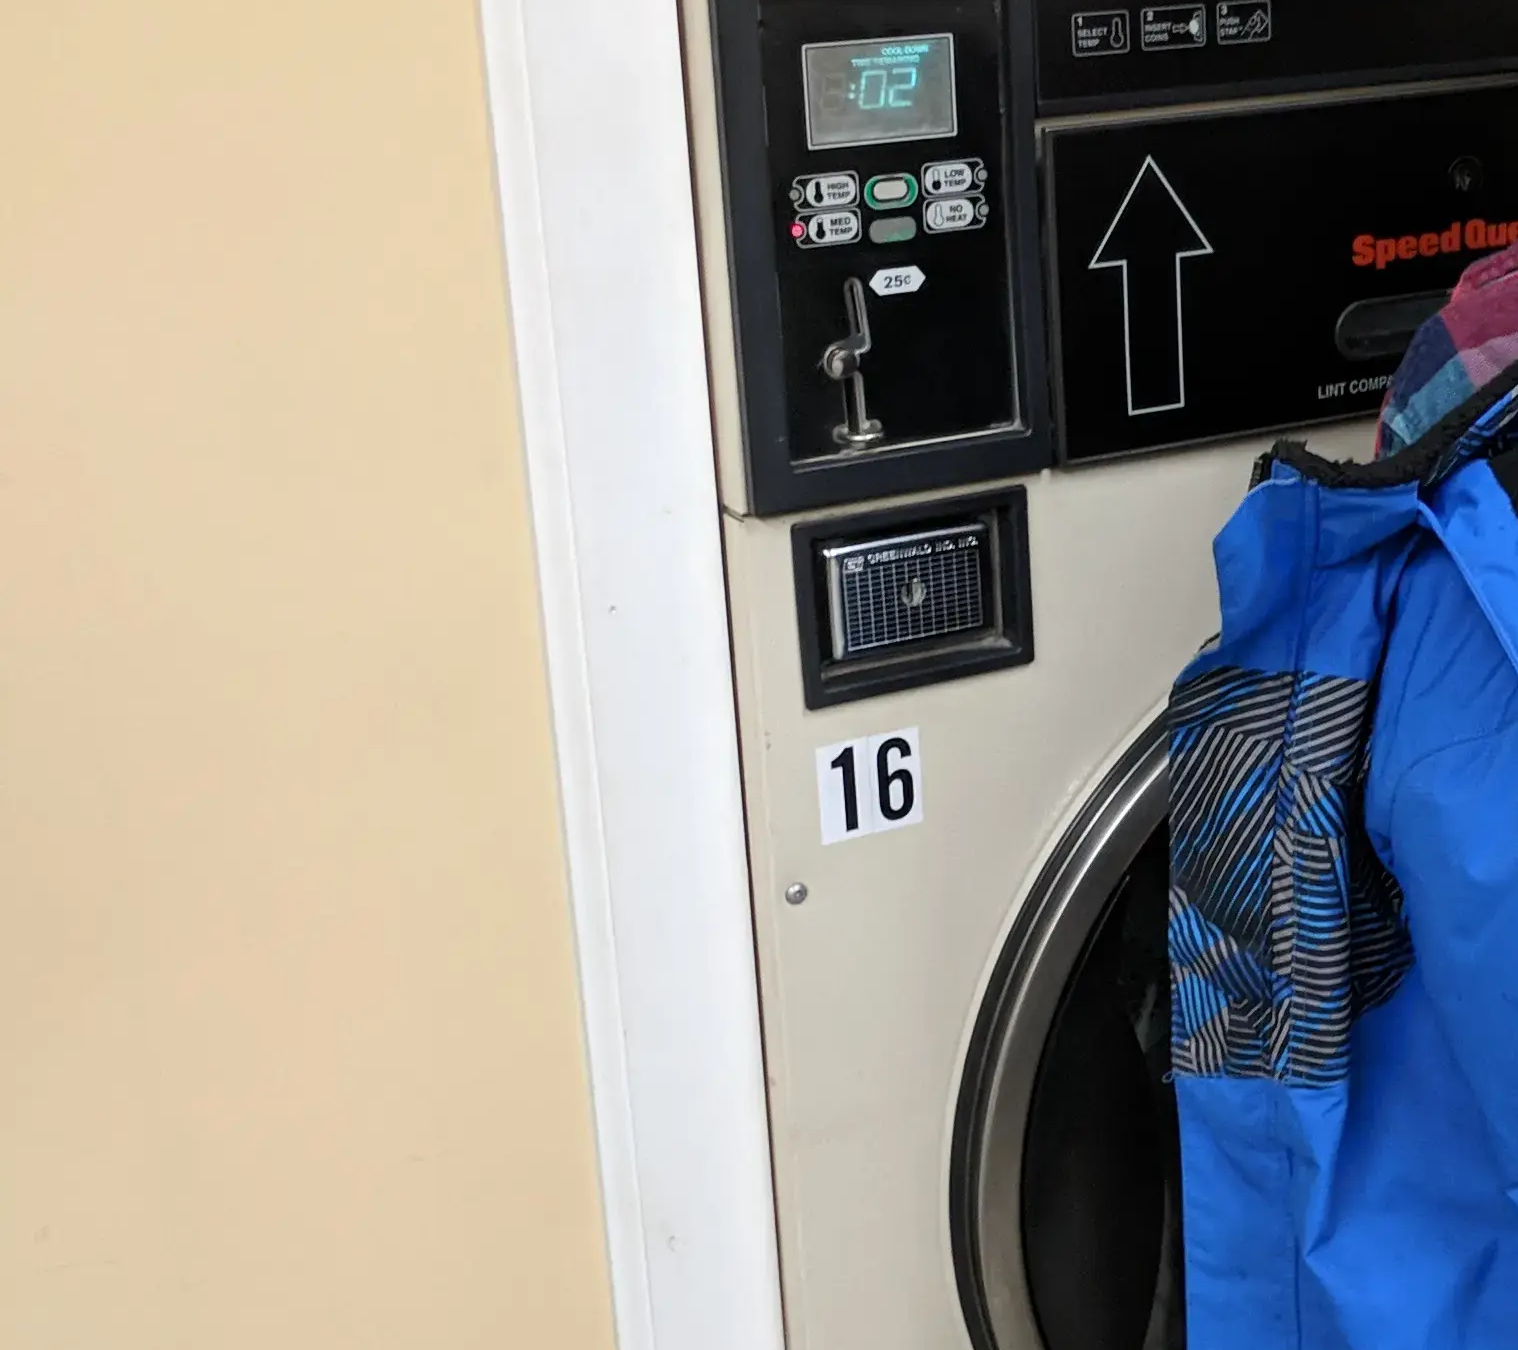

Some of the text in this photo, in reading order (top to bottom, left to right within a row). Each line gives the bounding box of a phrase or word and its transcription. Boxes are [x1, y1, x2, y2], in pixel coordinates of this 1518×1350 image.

[944, 168, 965, 178] LOW
[827, 181, 850, 191] HIGH
[944, 178, 967, 188] TEMP
[827, 191, 851, 201] TEMP
[830, 217, 851, 226] MED
[829, 226, 853, 237] TEMP
[1351, 221, 1461, 270] Speed
[1317, 381, 1347, 400] LINT
[830, 737, 915, 833] 16
